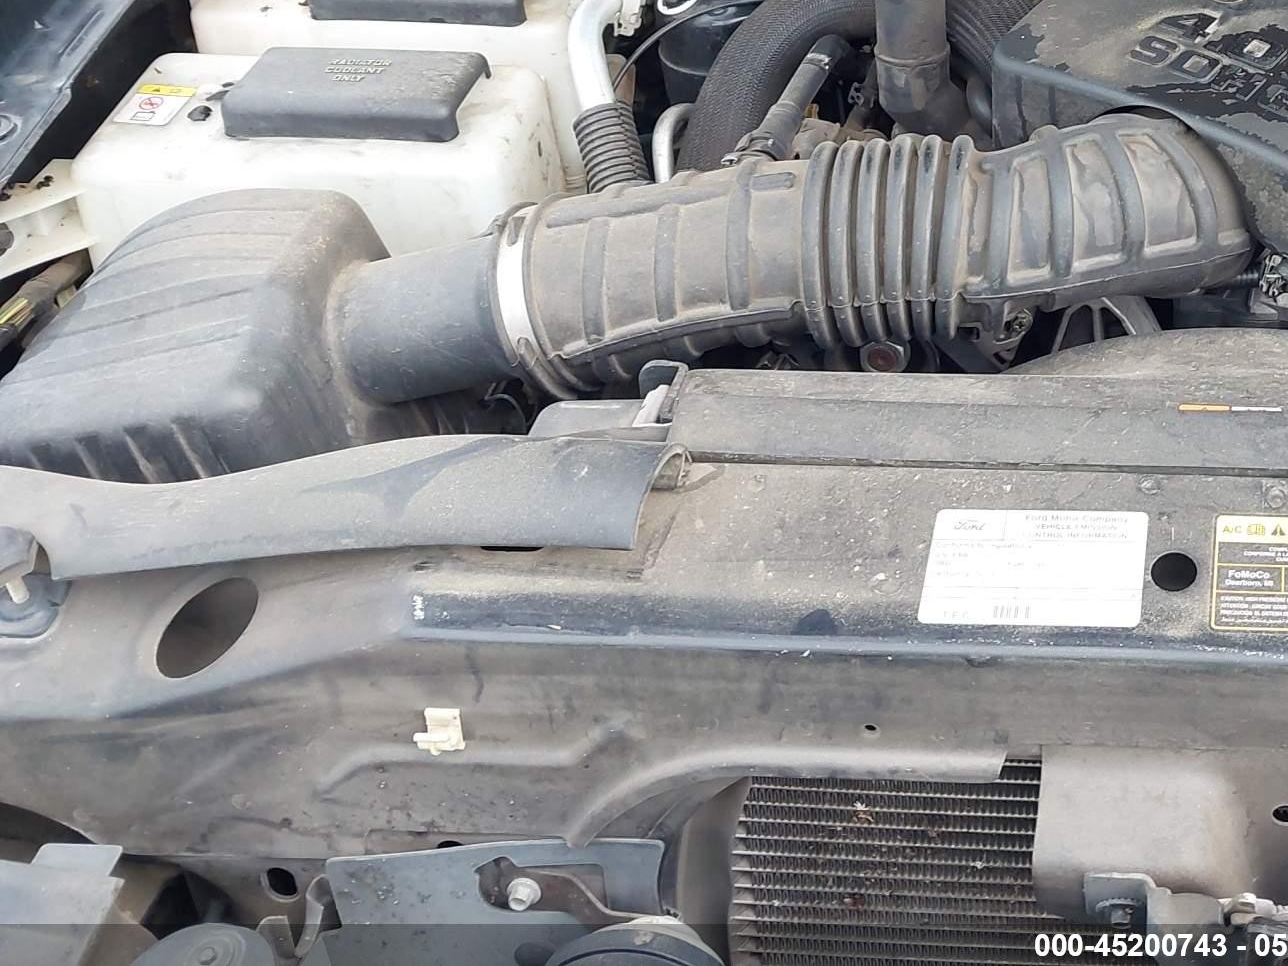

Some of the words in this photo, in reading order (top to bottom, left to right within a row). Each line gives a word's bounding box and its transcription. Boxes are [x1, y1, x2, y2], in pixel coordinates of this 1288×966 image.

[328, 58, 392, 66] RADIATOR
[324, 66, 384, 74] COOLANT
[332, 74, 365, 82] ONLY
[953, 519, 985, 531] Ford
[1222, 525, 1242, 533] A/C
[1228, 570, 1270, 579] FoMoCo
